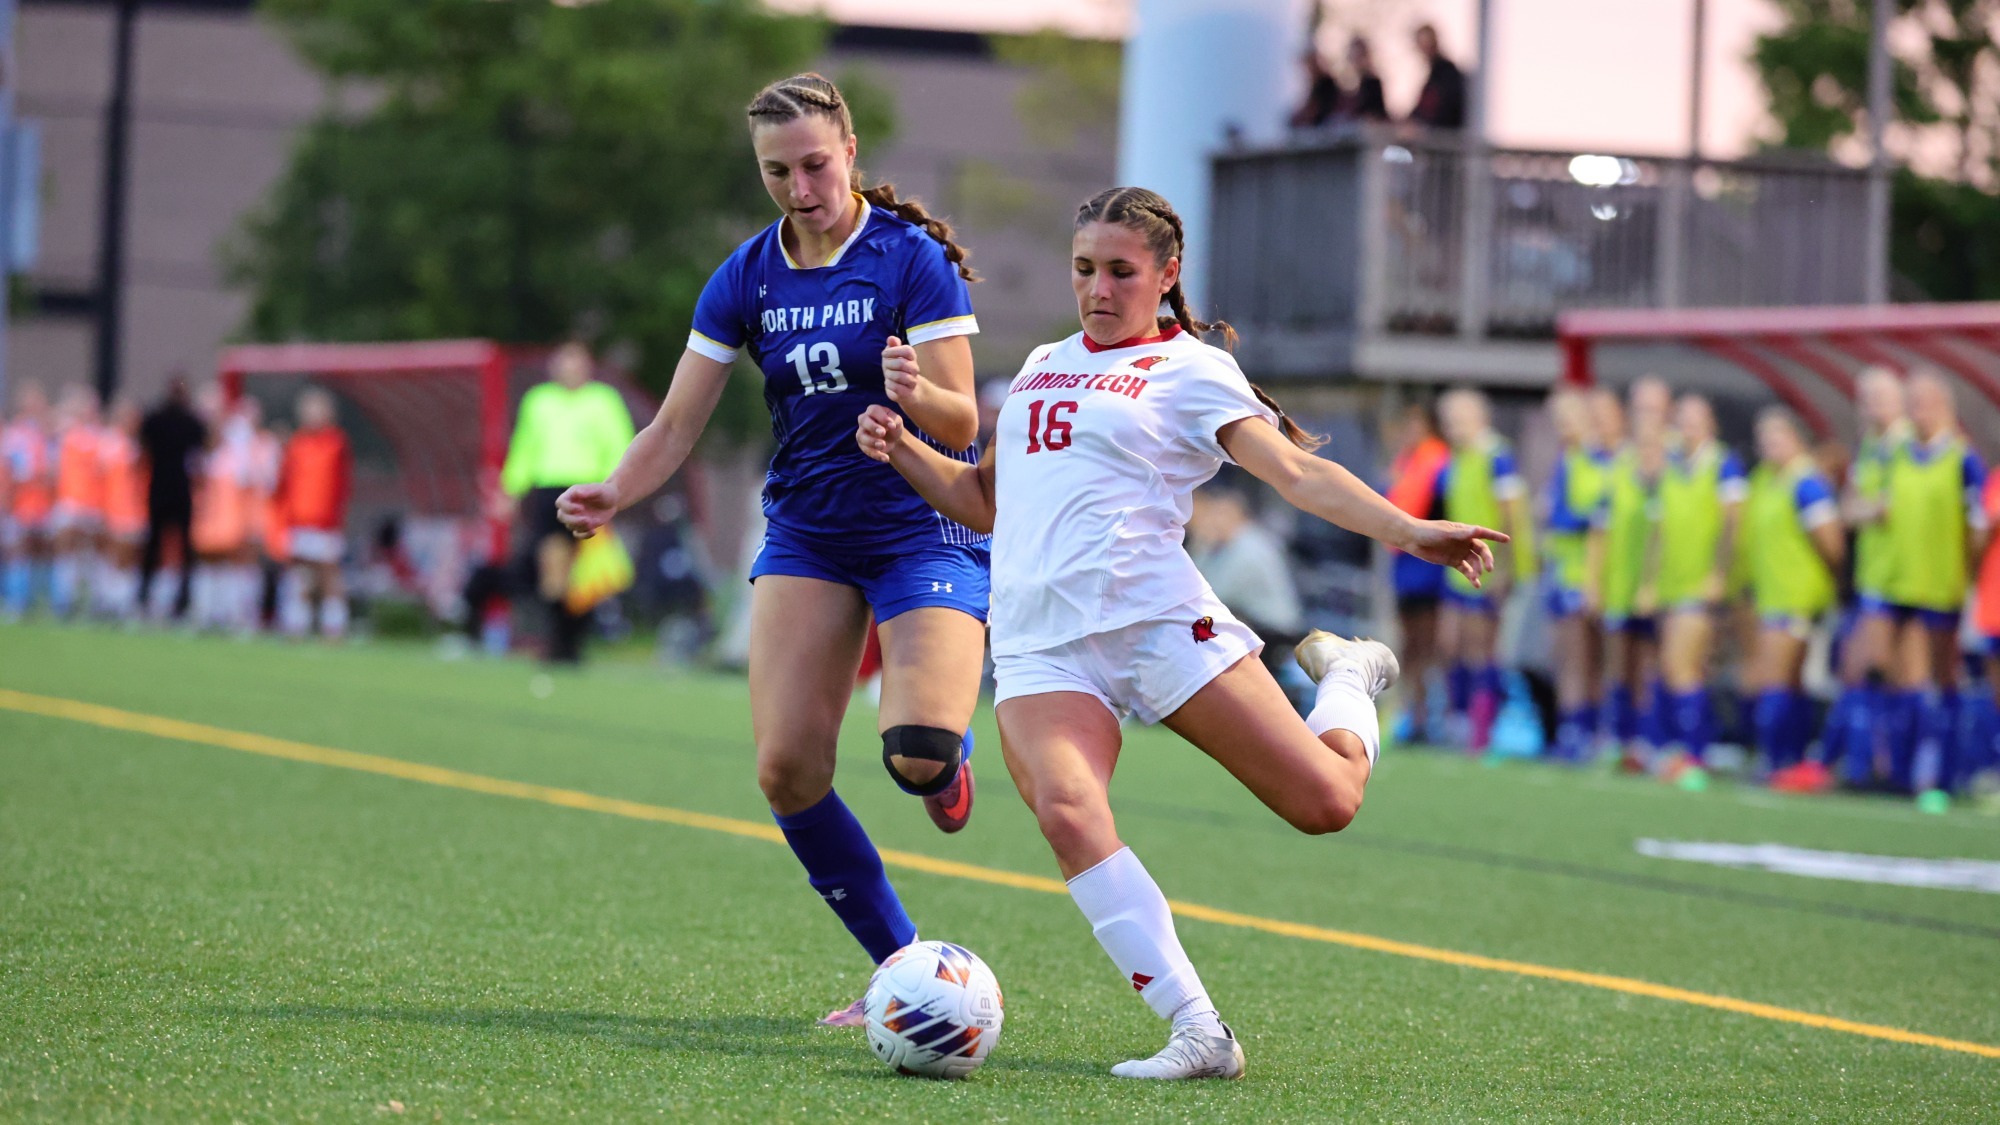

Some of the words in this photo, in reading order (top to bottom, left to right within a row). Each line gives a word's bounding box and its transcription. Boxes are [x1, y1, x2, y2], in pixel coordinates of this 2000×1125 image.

[821, 298, 875, 328] PARK
[785, 341, 848, 396] 13
[1084, 374, 1148, 399] TECH
[1026, 400, 1079, 454] 16
